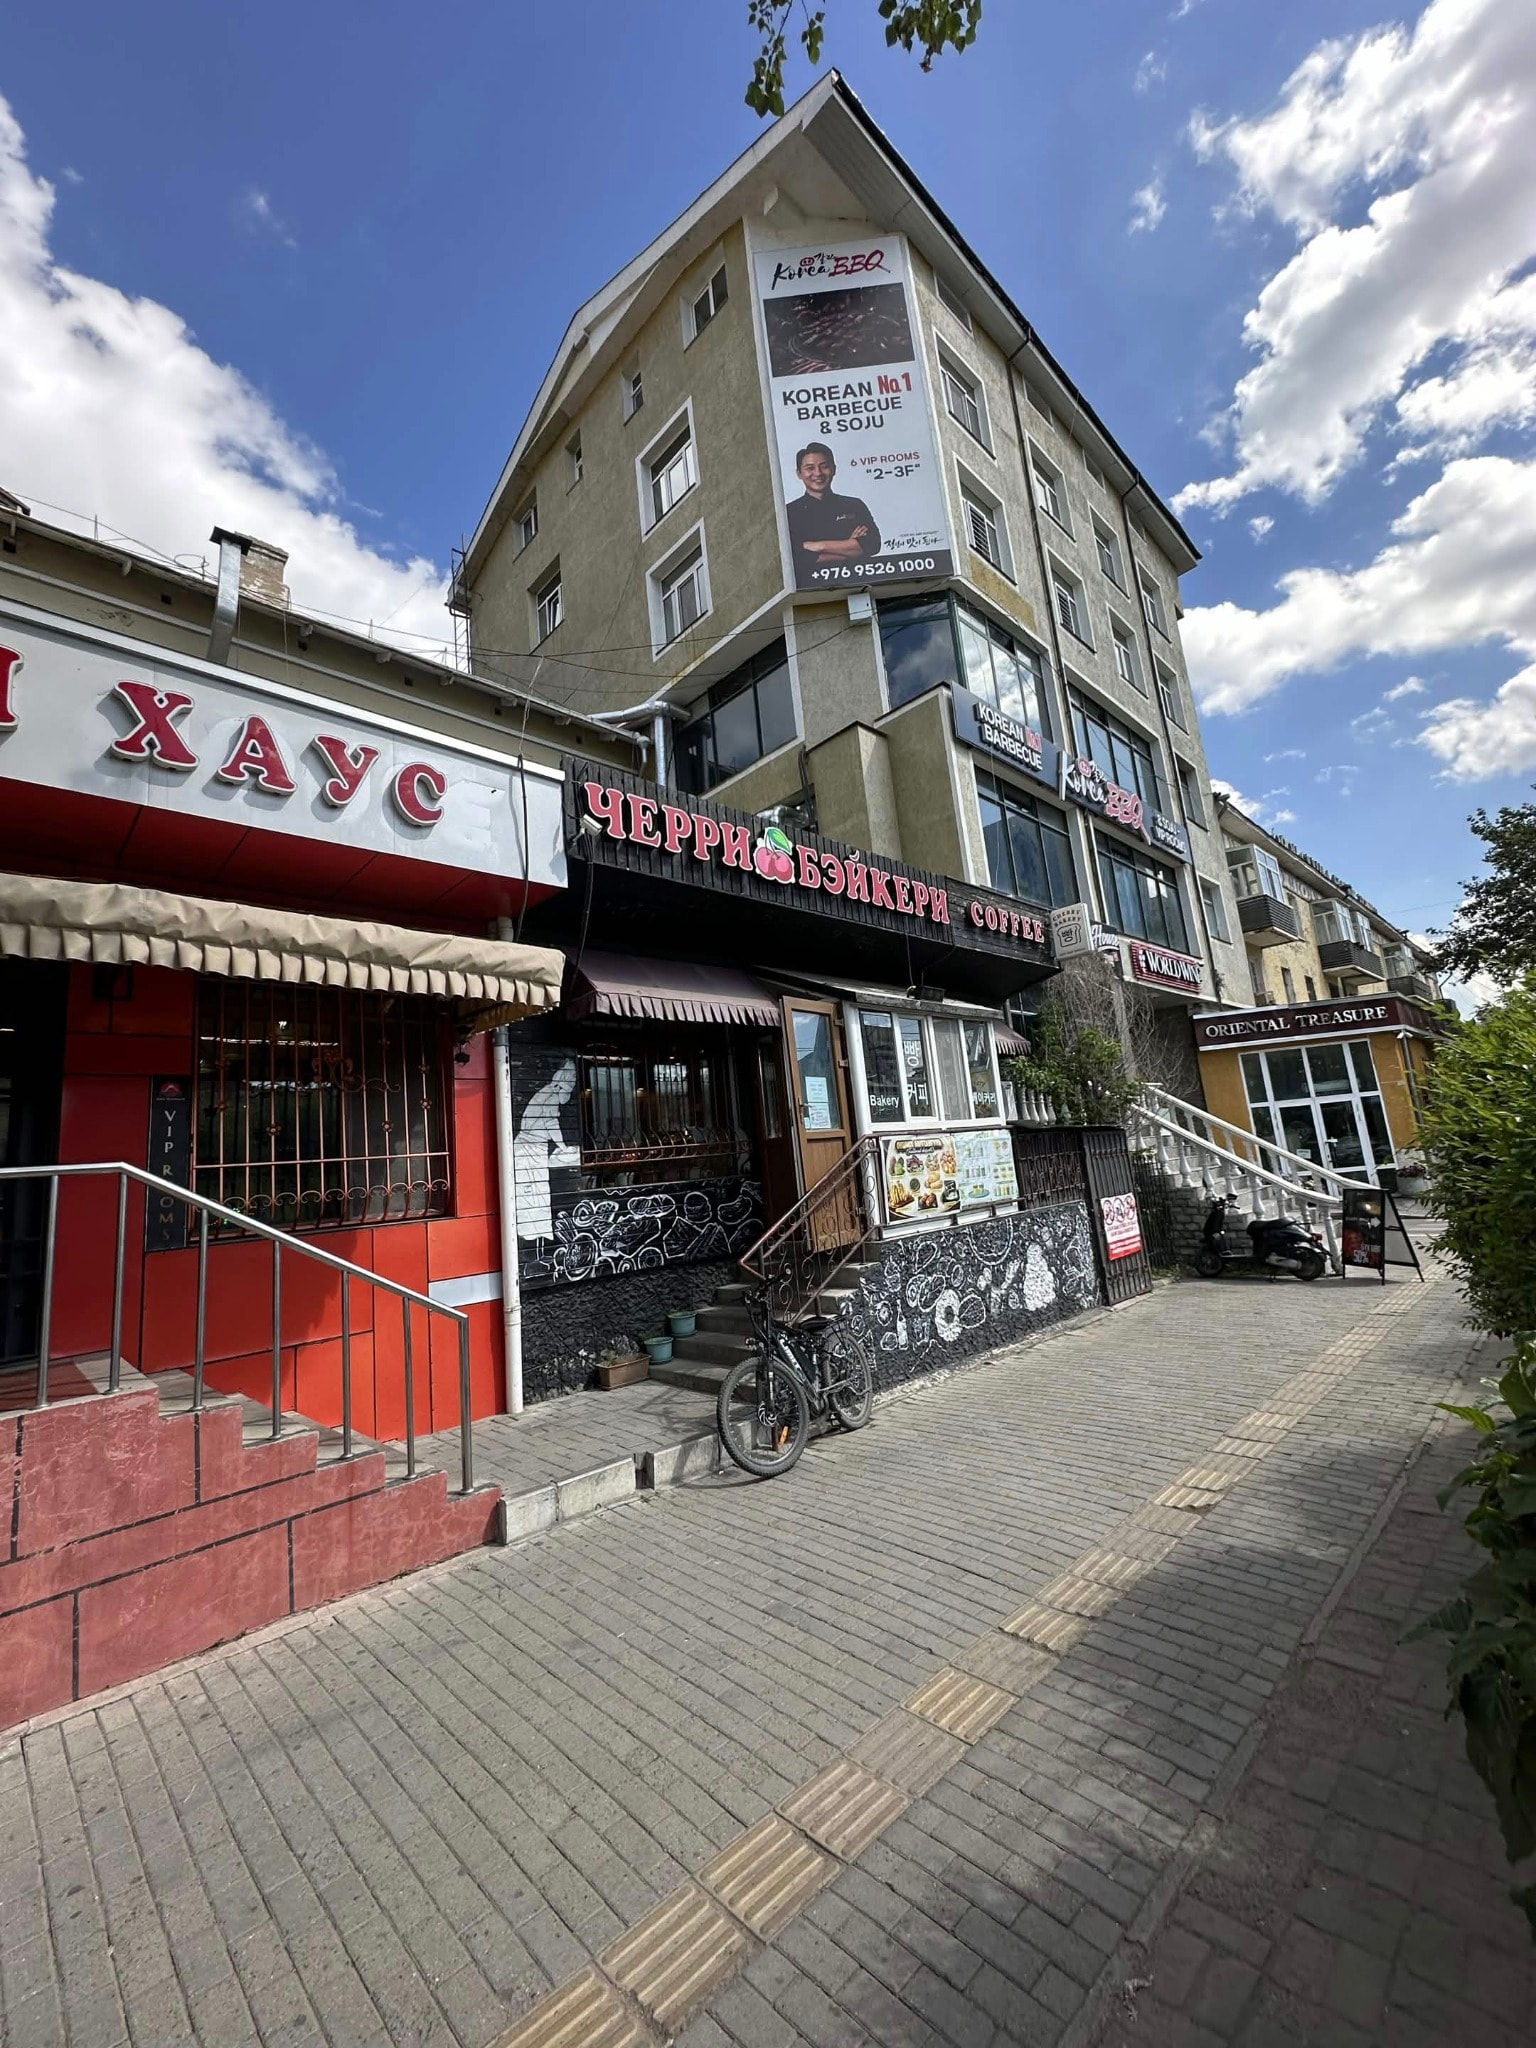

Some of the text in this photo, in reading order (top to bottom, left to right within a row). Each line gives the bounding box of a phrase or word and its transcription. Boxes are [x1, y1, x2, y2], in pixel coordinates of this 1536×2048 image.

[771, 262, 830, 290] Korea
[828, 249, 891, 277] BBQ
[782, 381, 873, 406] KOREAN
[797, 396, 902, 421] BARBECUE
[820, 414, 885, 434] & SOJU
[850, 451, 920, 467] 6 VIP ROOMS
[811, 558, 935, 580] +976 9526 1000
[977, 701, 1026, 744] KOREAN
[111, 680, 448, 827] ХАУС
[983, 723, 1043, 771] BARBECUE
[1105, 780, 1151, 846] BBQ
[584, 782, 951, 924] ЧЕРРИ БЭЙКЕРИ
[970, 901, 1045, 943] COFFEE
[1145, 950, 1182, 980] WORLD
[1205, 1006, 1389, 1038] ORIENTAL TREASURE
[903, 1040, 921, 1067] 빵
[869, 1094, 899, 1109] Bakery
[907, 1083, 929, 1105] 커피
[164, 1110, 176, 1153] VIP
[158, 1164, 175, 1241] ROMS
